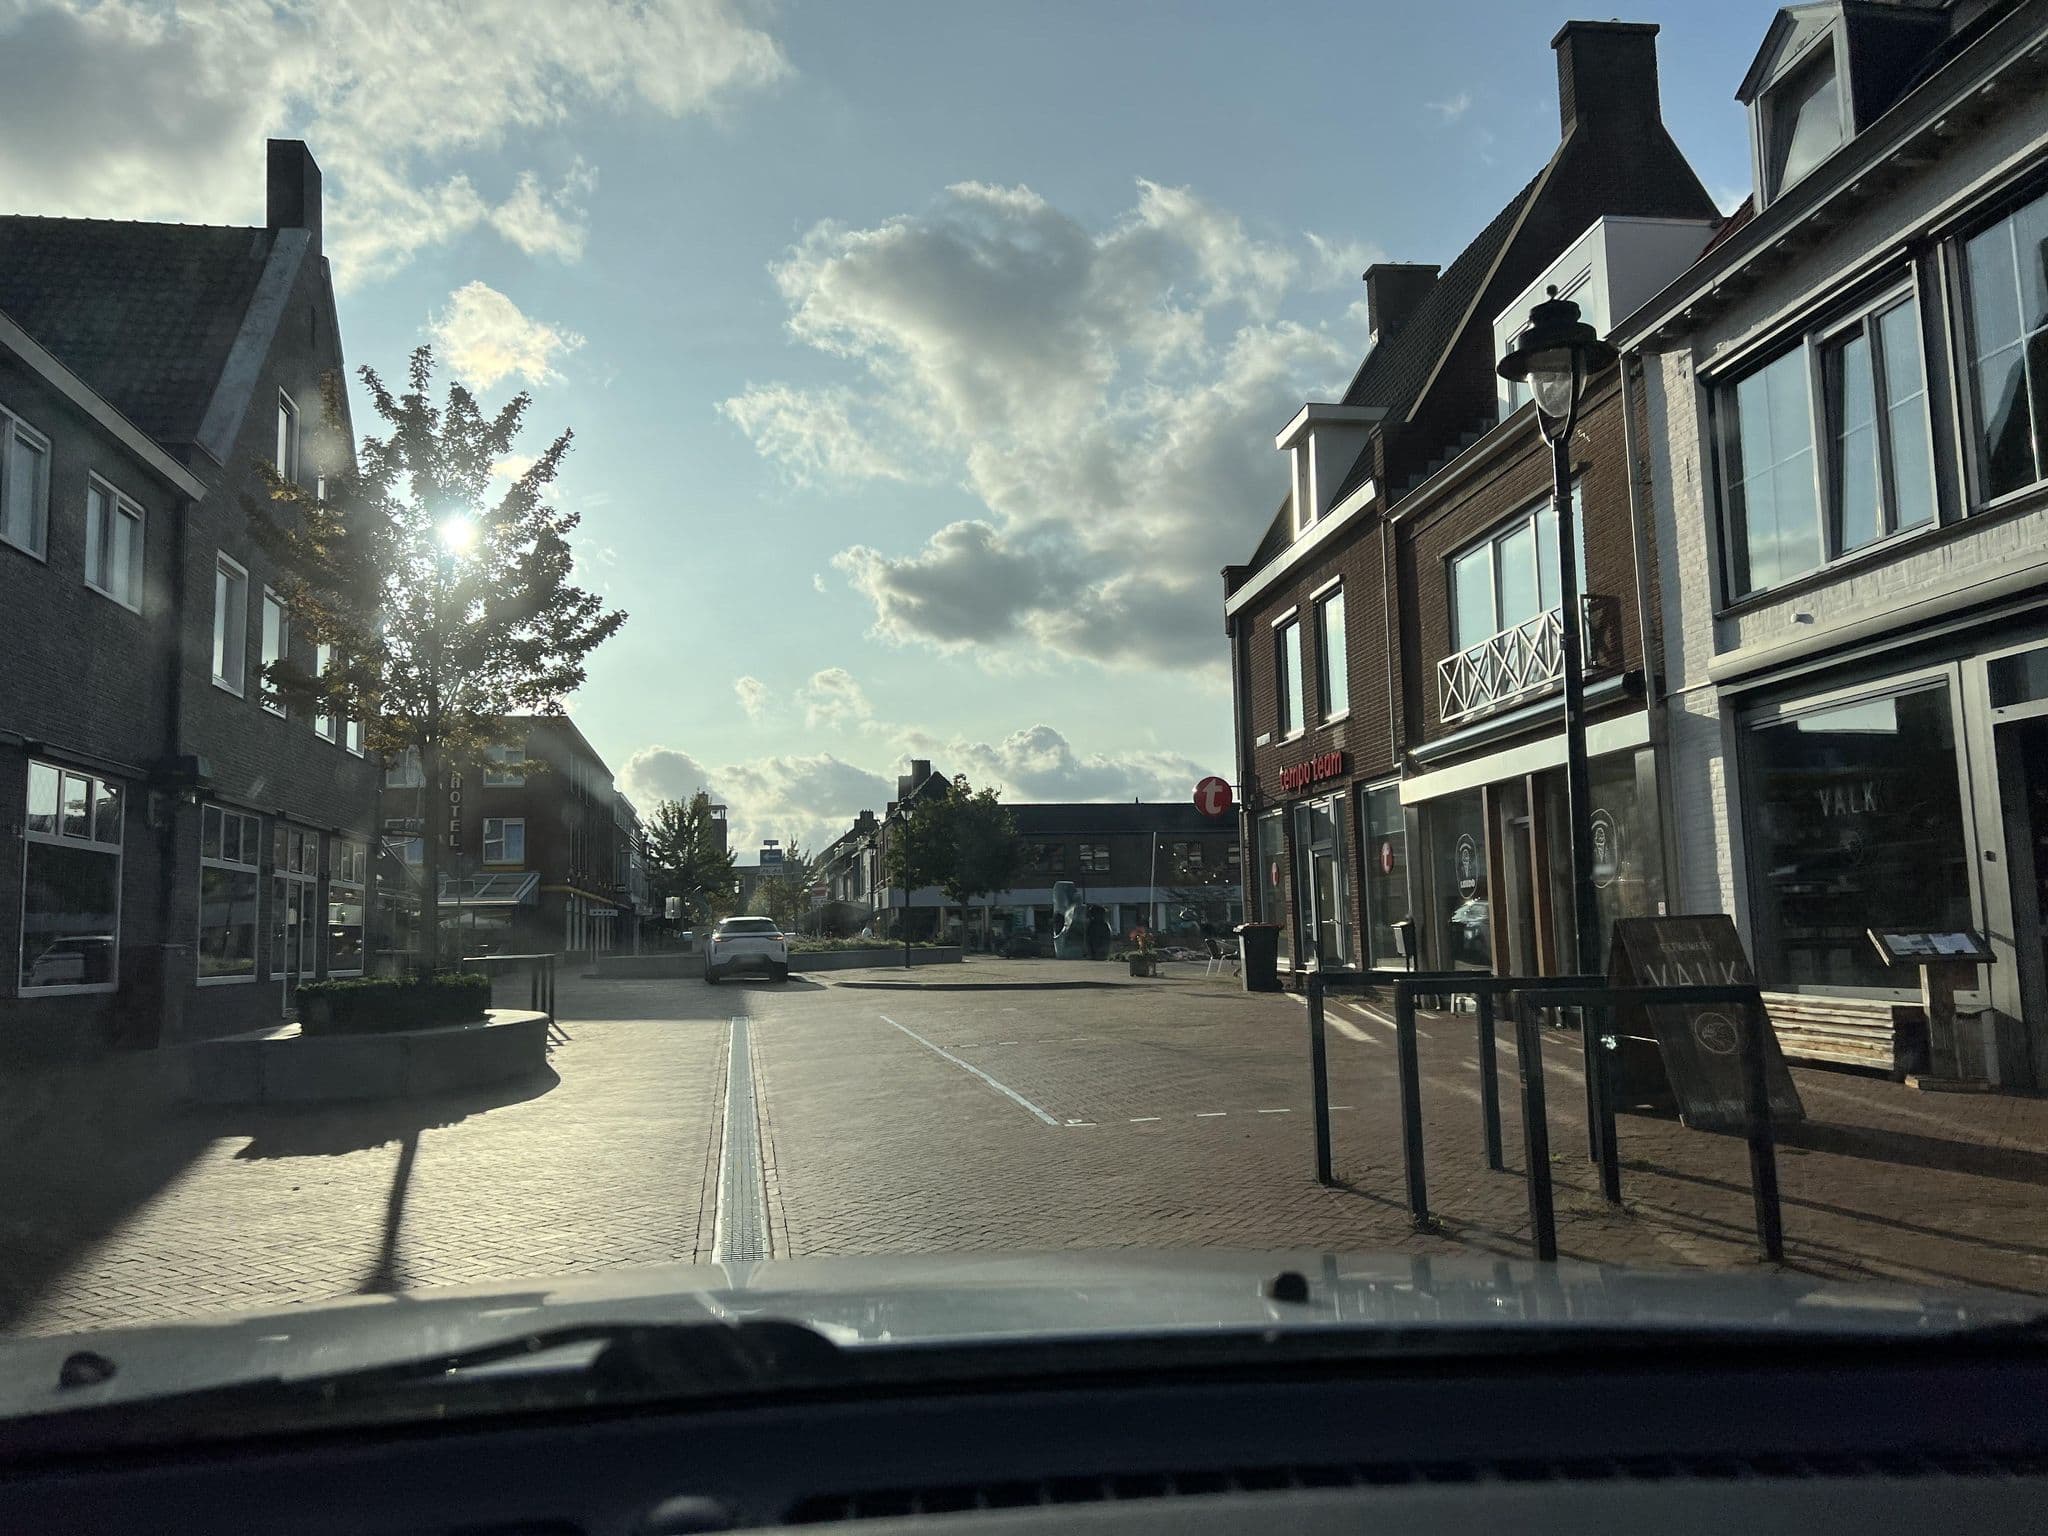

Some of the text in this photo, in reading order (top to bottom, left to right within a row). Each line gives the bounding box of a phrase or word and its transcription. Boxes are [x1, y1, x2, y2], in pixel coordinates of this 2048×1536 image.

[1279, 751, 1343, 794] tempo team
[449, 776, 461, 847] HOTEL
[1202, 779, 1223, 815] t
[1819, 783, 1876, 816] VALK
